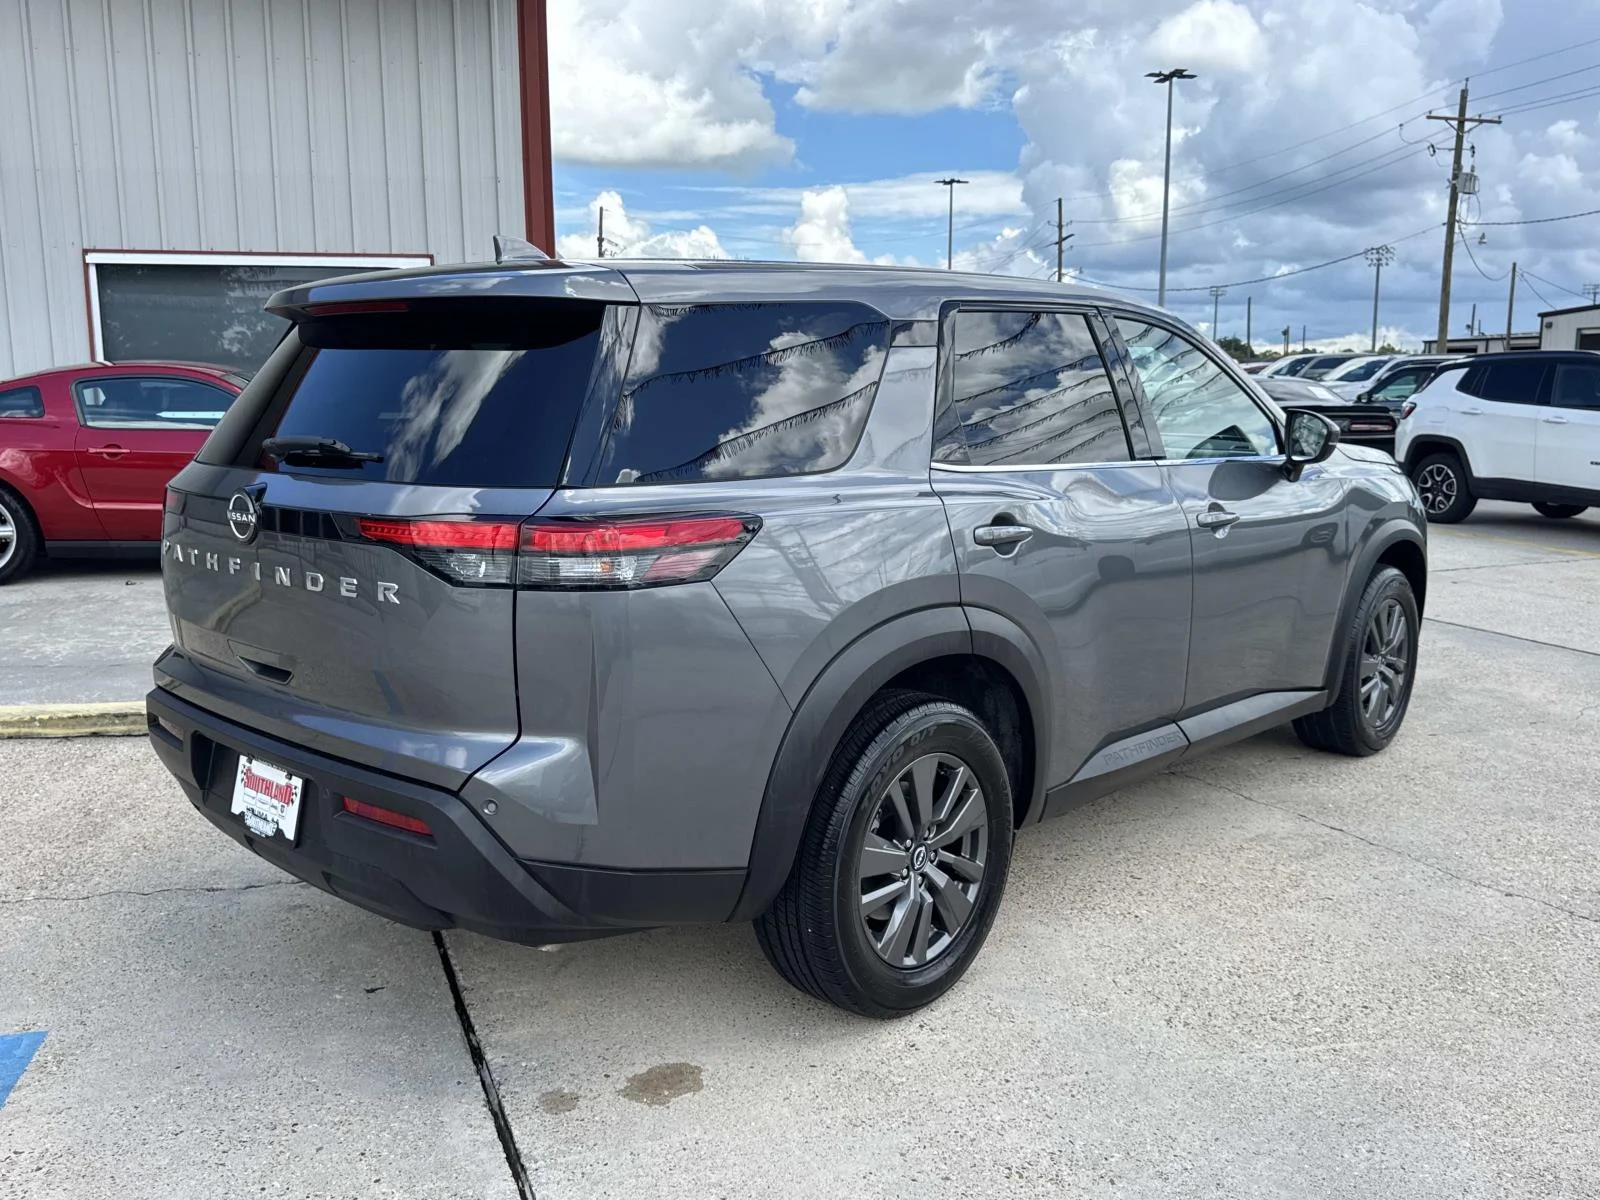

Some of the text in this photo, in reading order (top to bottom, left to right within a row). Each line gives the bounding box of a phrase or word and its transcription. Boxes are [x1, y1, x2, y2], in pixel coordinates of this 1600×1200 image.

[163, 540, 400, 604] PATHFINDER
[1103, 731, 1181, 766] PATHFINDER
[244, 767, 293, 806] SOUTHLAND
